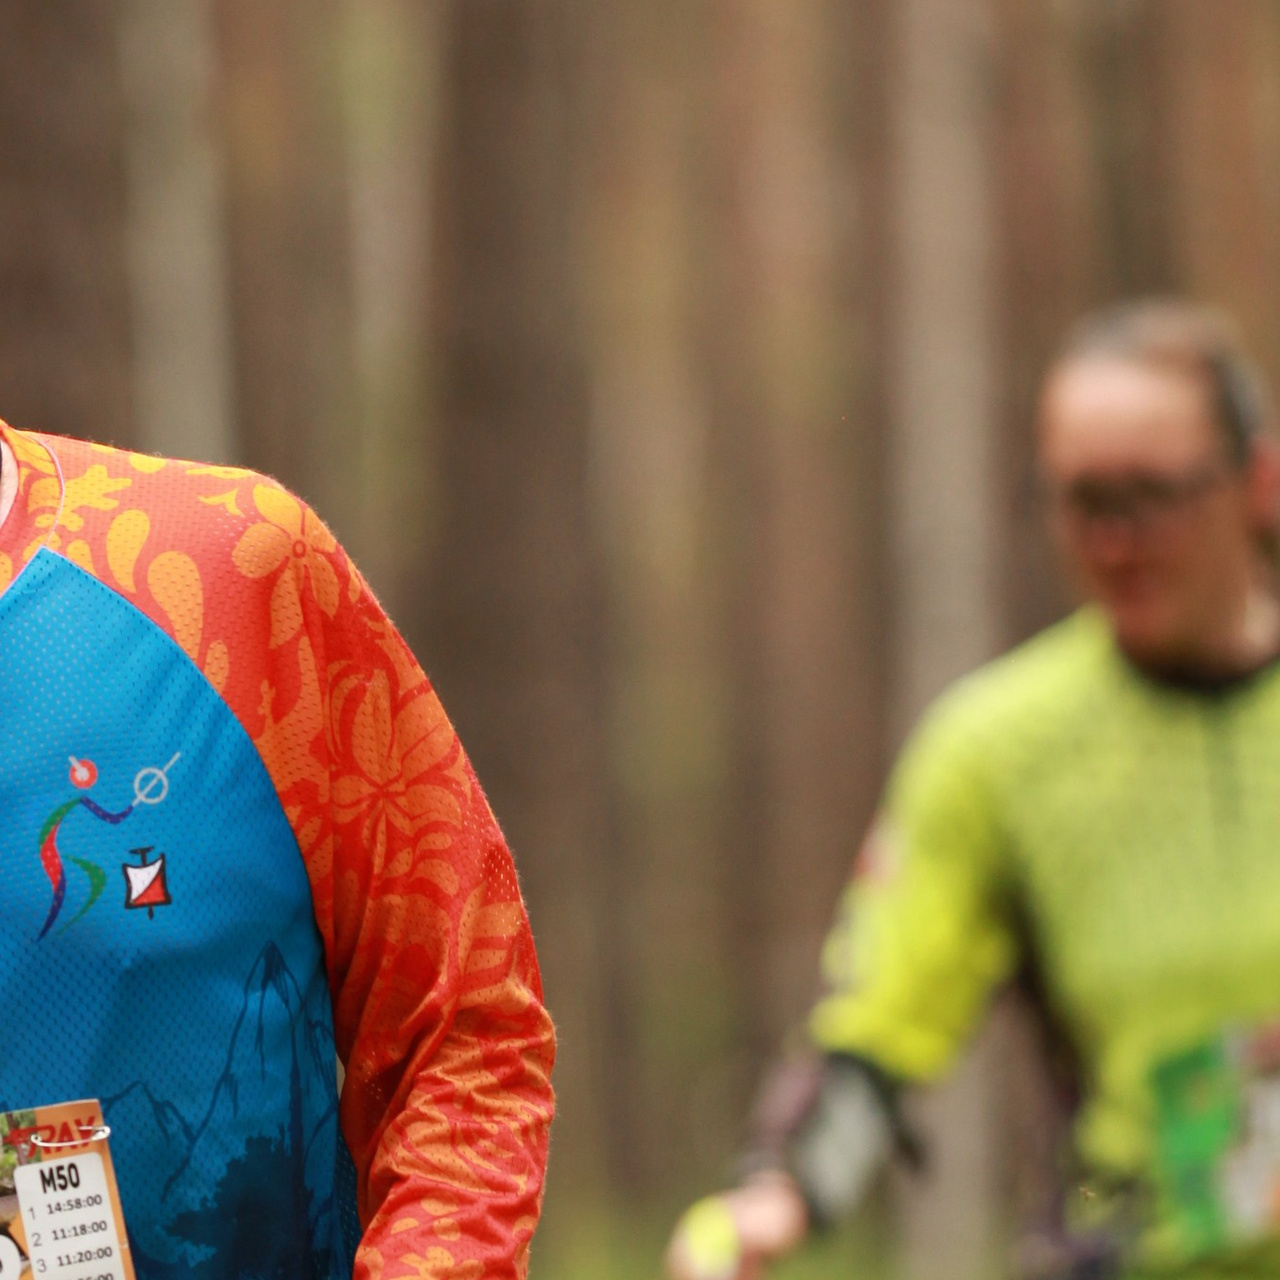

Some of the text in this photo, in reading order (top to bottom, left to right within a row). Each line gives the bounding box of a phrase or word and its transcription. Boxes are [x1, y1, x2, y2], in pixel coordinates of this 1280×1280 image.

[29, 1194, 103, 1220] 1 14:58:00
[32, 1220, 108, 1247] 2 11:18:00
[36, 1247, 113, 1273] 3 11:20:00
